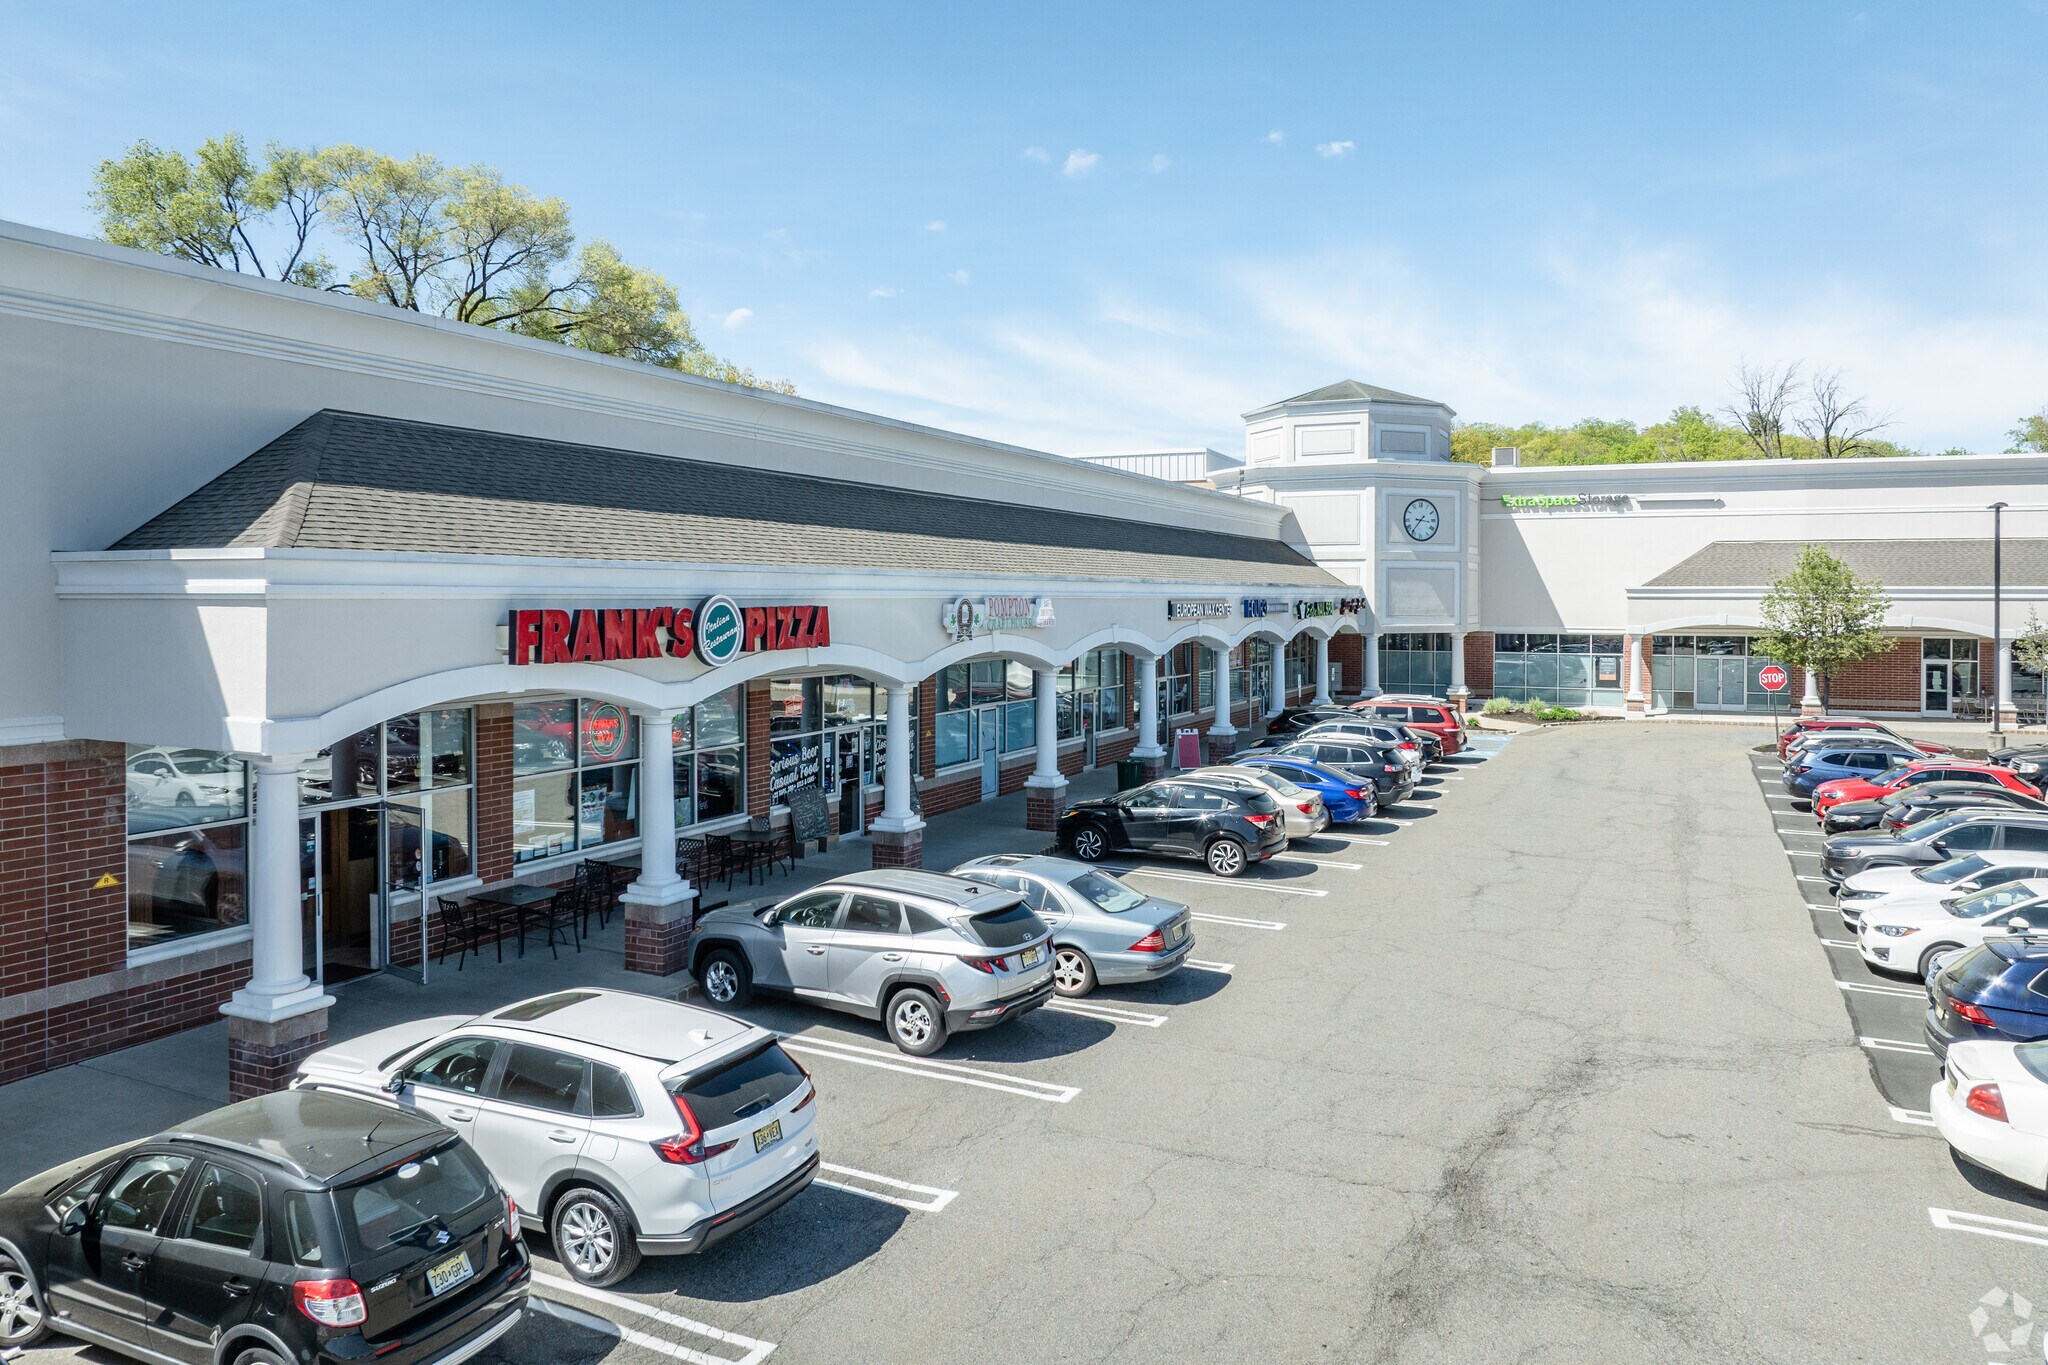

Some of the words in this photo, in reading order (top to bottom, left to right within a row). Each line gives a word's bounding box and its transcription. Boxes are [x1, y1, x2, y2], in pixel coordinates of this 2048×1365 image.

[1578, 492, 1629, 507] Storage
[987, 597, 1031, 617] POMPTON
[1176, 603, 1203, 617] EUROPEAN
[1204, 603, 1215, 616] WAX
[1215, 603, 1232, 616] CENTER
[705, 614, 730, 633] Italian
[742, 605, 831, 652] PIZZA
[509, 606, 694, 665] FRANK'S
[703, 622, 741, 650] Restaurant
[1761, 673, 1785, 683] STOP
[770, 754, 800, 775] Serious
[801, 745, 819, 761] Beer
[770, 766, 799, 792] Casual
[800, 757, 819, 778] Food
[370, 1278, 397, 1293] SUZUKI
